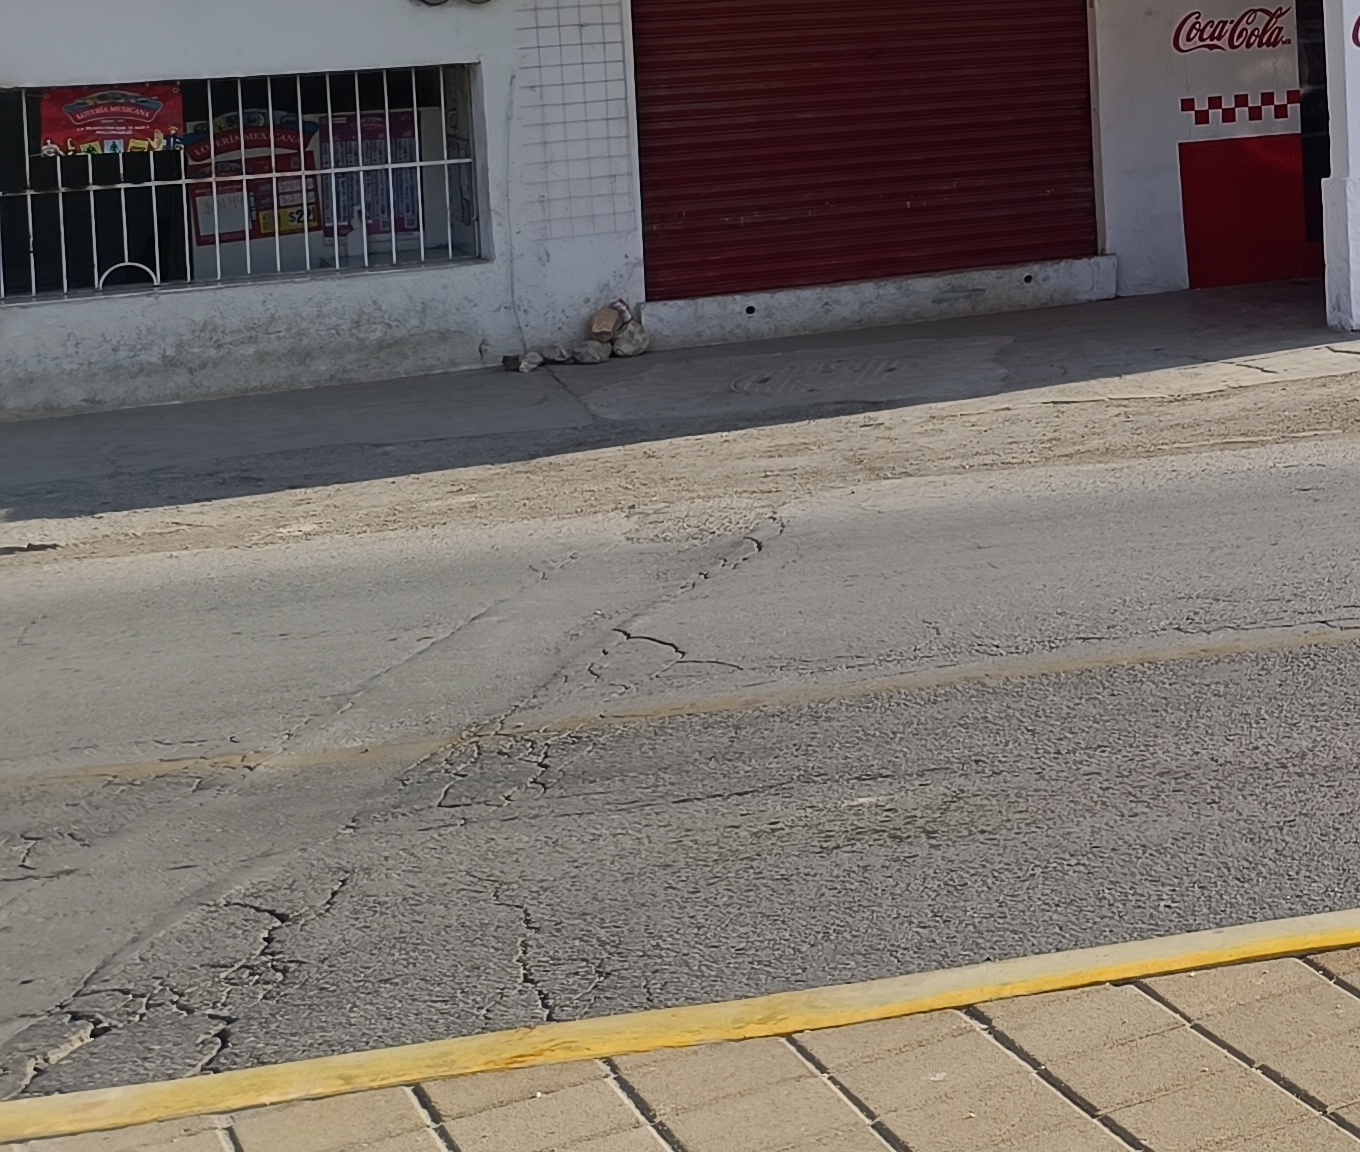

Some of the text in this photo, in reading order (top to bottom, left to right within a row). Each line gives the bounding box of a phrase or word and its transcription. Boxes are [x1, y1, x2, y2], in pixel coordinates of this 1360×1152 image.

[1173, 6, 1292, 53] Coca-Cola
[194, 132, 301, 156] LOERÍA MEXCAN
